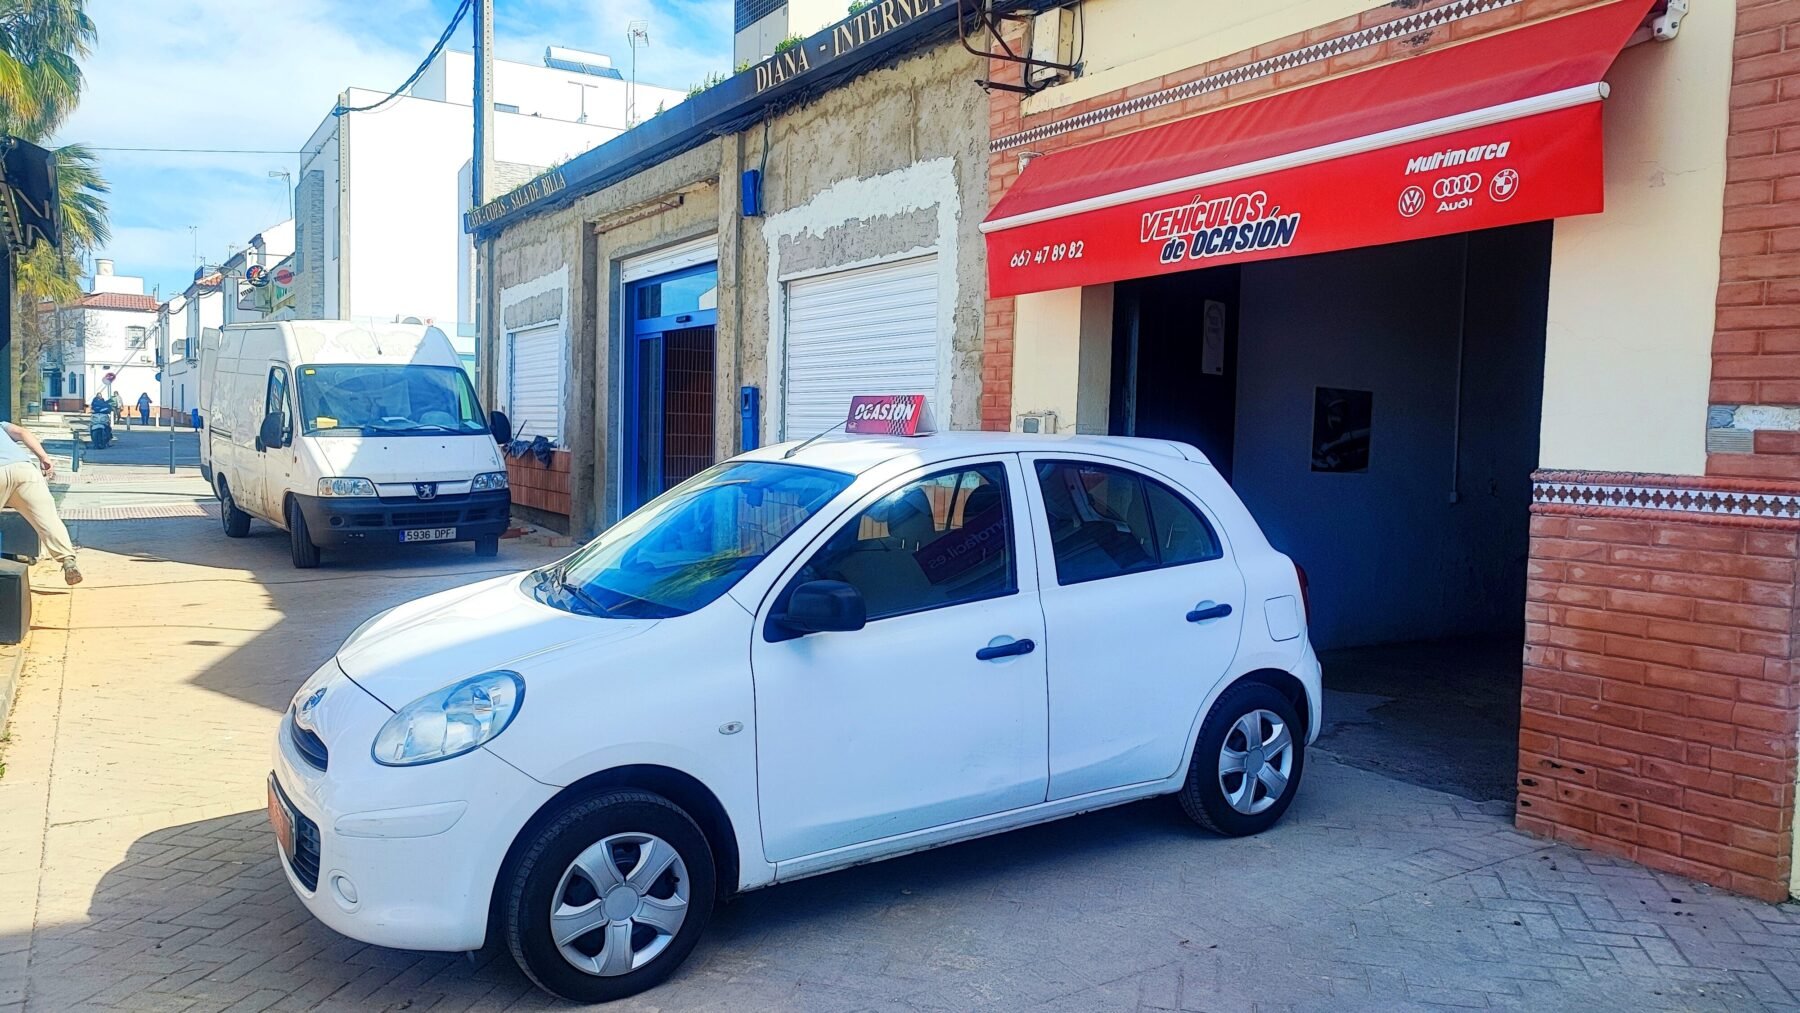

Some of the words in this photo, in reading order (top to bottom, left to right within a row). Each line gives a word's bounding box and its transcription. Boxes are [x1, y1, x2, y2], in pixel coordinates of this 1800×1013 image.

[755, 44, 810, 93] DIANA
[1405, 141, 1511, 175] Multimarca
[485, 200, 506, 221] COPAS
[510, 187, 530, 210] SALA
[527, 181, 541, 202] DE
[1141, 192, 1266, 242] VEHÍCULOS
[1436, 197, 1473, 213] Audi
[1160, 236, 1187, 264] de
[1189, 206, 1300, 258] OCASIÓN
[1010, 249, 1031, 268] 667
[1034, 245, 1050, 264] 47
[1051, 243, 1067, 261] 89
[1068, 240, 1084, 259] 82
[407, 530, 430, 540] 5936
[435, 528, 451, 539] DPF
